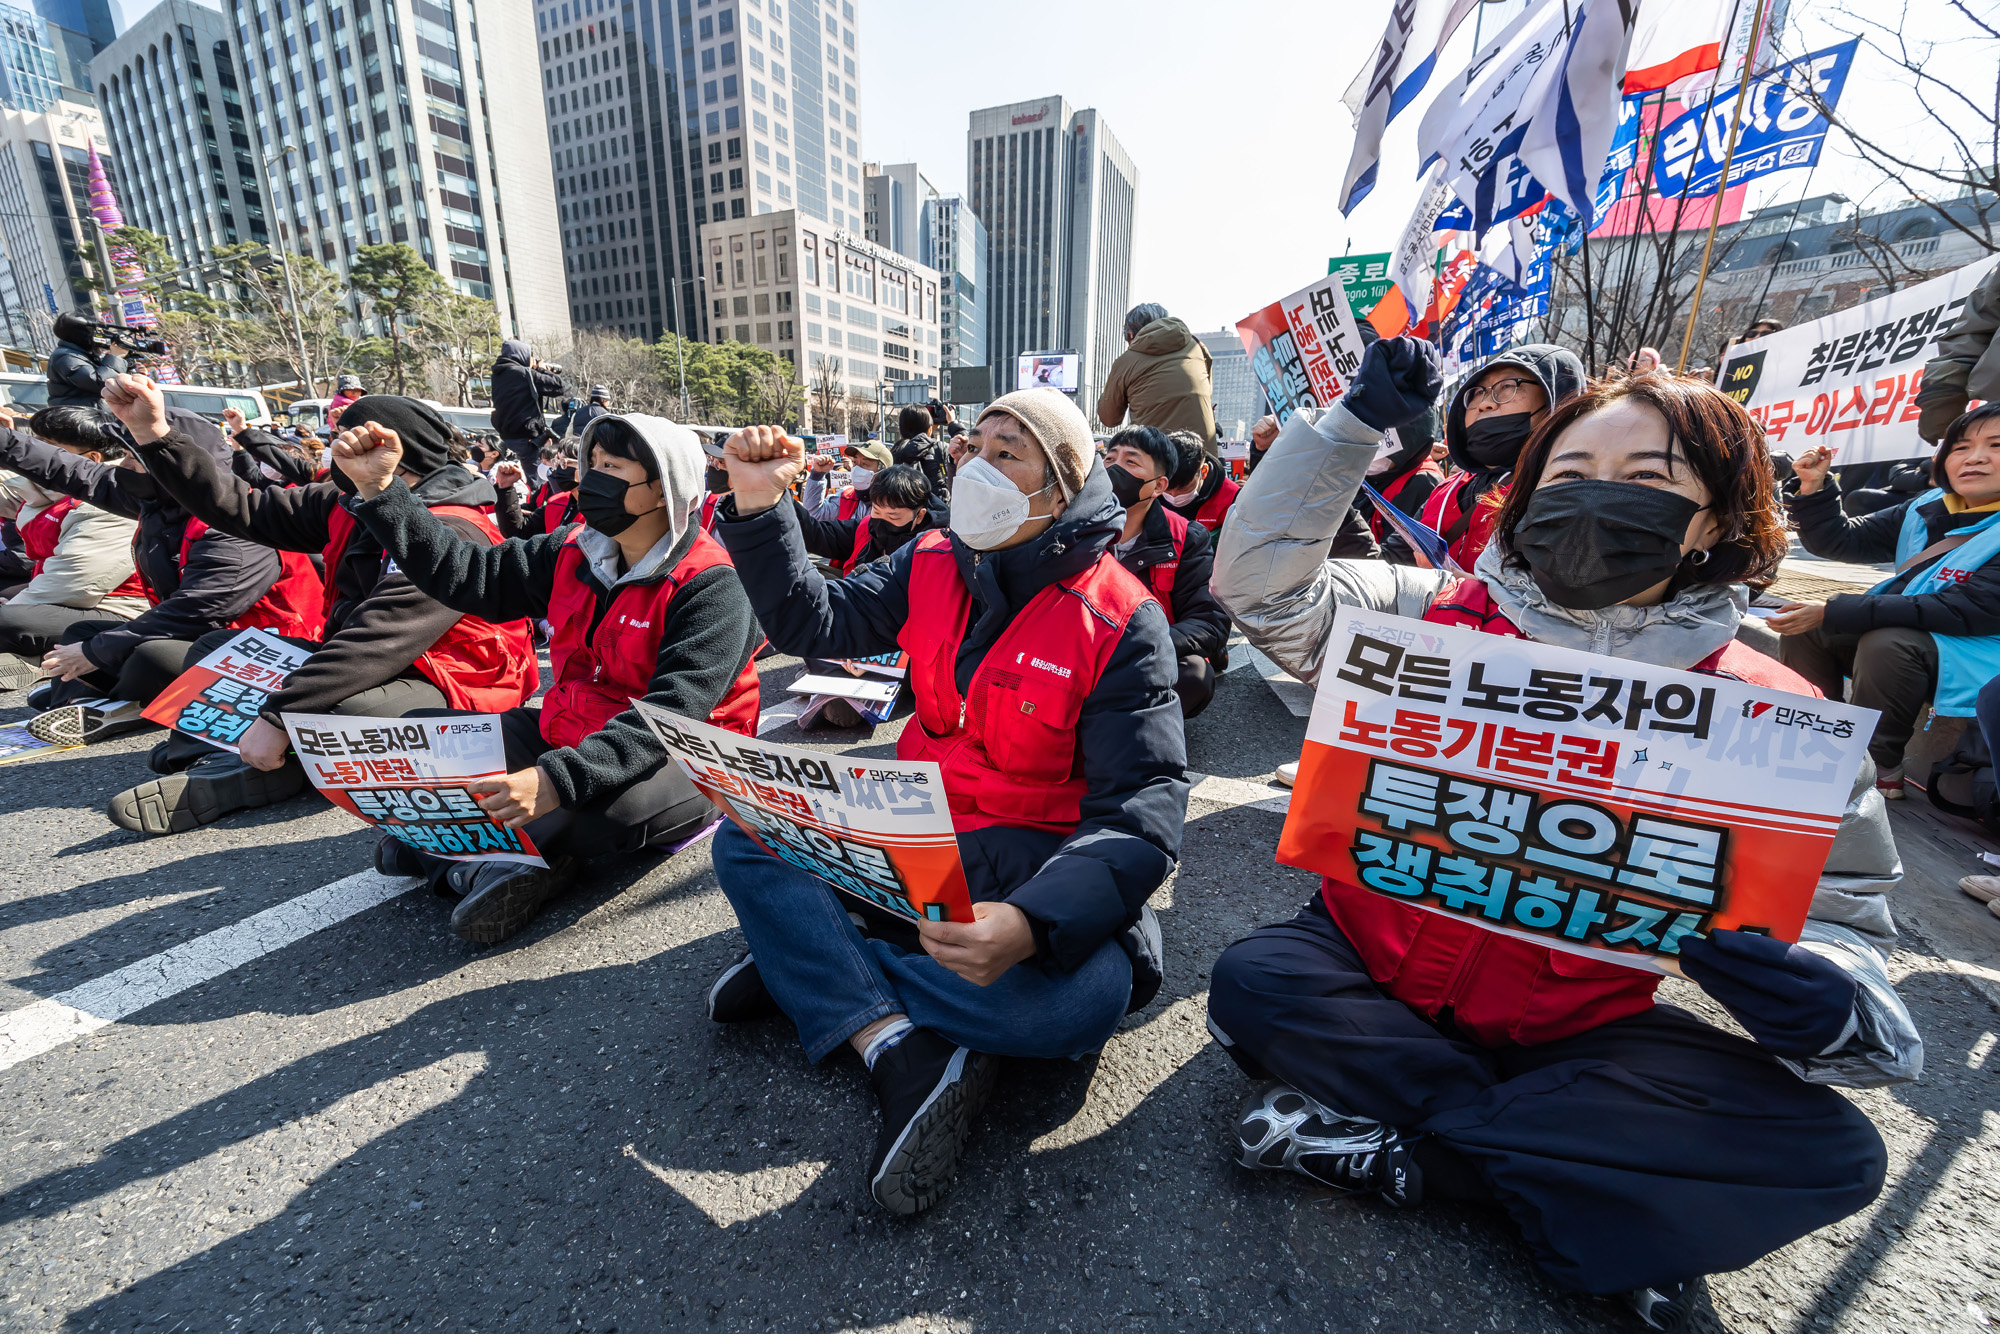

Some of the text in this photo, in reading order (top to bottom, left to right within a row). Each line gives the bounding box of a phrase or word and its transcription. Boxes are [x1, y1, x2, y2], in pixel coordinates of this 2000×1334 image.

[1287, 303, 1344, 402] 노동기본권
[1309, 286, 1360, 391] 모든 노동
[1271, 331, 1319, 408] 투쟁으
[1732, 364, 1754, 382] NO
[991, 508, 1011, 521] KF94
[1934, 566, 1976, 584] 보당
[230, 636, 283, 666] 모든
[213, 655, 285, 690] 노동기
[1336, 633, 1717, 740] 모든 노동자의
[295, 726, 345, 757] 모든
[344, 723, 431, 754] 노동자의
[450, 722, 492, 735] 민주노총
[1774, 706, 1856, 739] 민주노총
[651, 718, 841, 794] 모든 노동자의
[1338, 699, 1621, 791] 노동기본권
[314, 757, 420, 785] 노동기본권
[868, 769, 930, 785] 민주노총
[347, 786, 487, 821] 투쟁으로
[683, 757, 820, 823] 노동기본권
[728, 797, 903, 893] 투쟁으로
[1360, 762, 1726, 907] 투쟁으로
